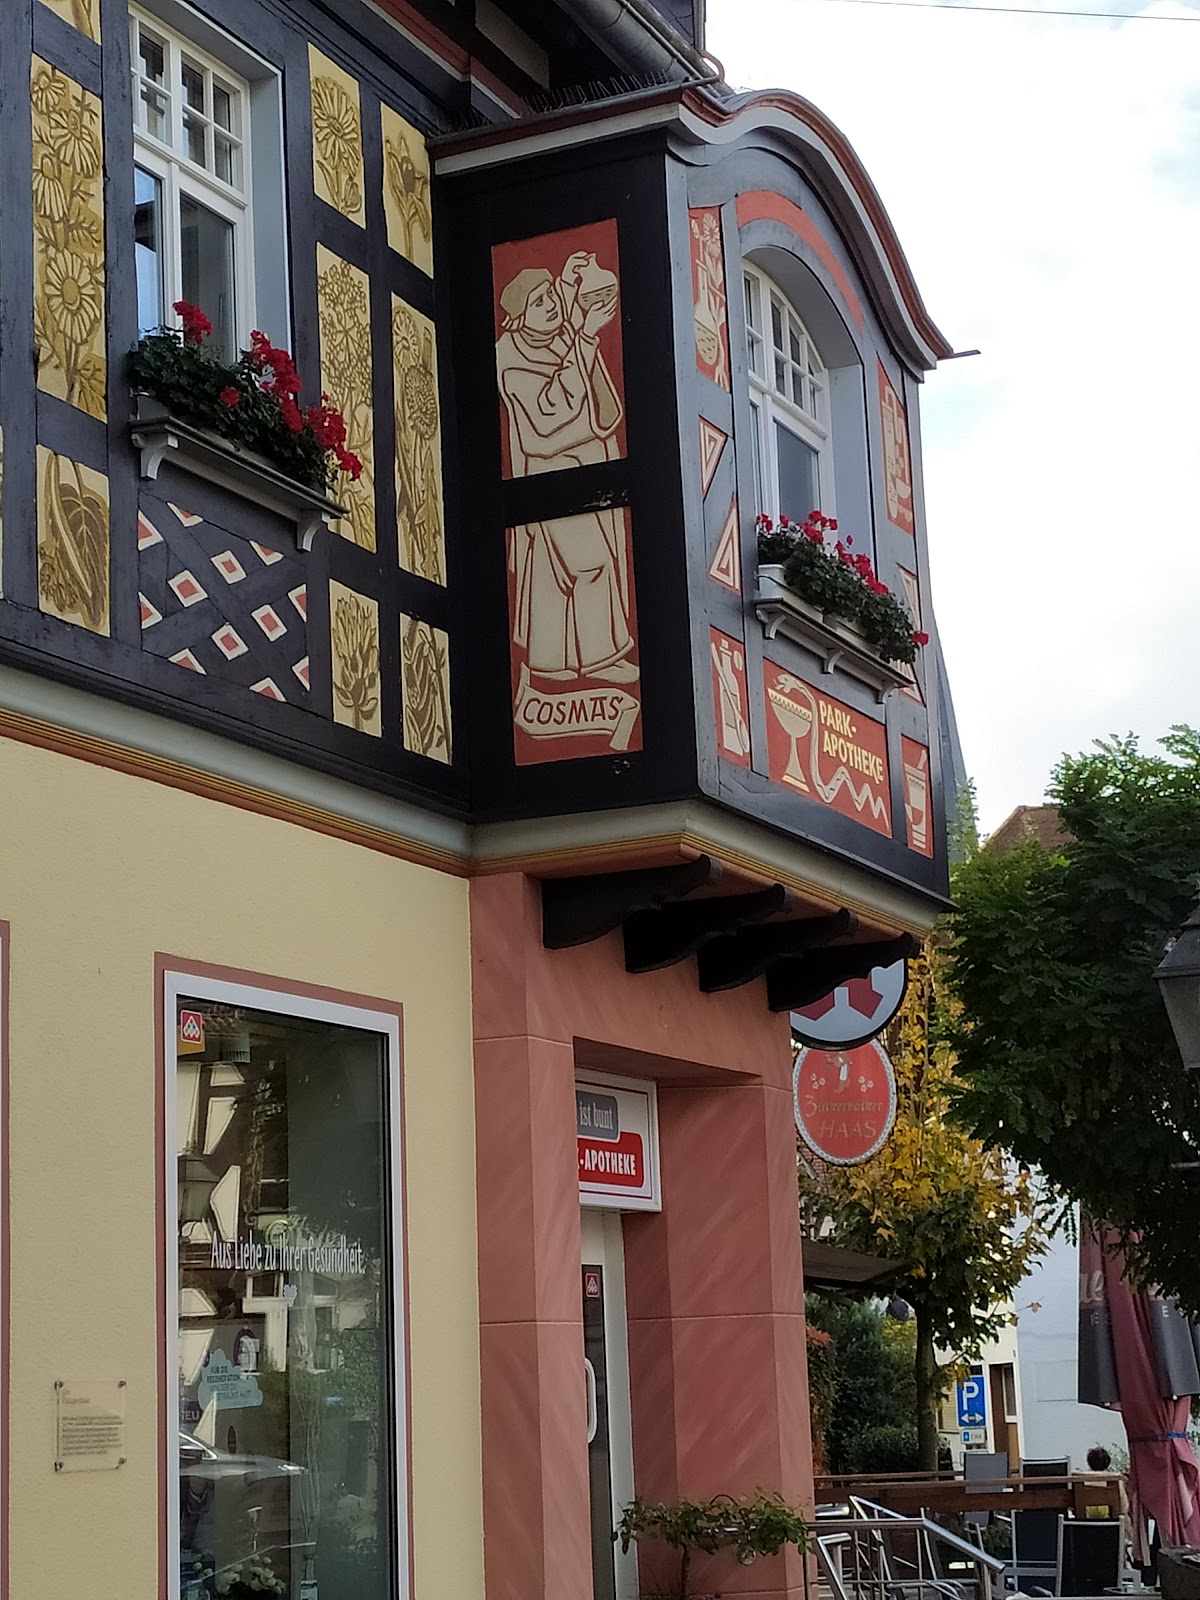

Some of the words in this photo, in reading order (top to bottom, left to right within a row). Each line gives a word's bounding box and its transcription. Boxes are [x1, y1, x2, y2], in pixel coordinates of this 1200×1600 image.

[523, 696, 623, 725] COSMAS
[819, 700, 857, 738] PARK-
[823, 730, 884, 784] APOTHEKE
[579, 1101, 591, 1127] ist
[593, 1102, 613, 1130] bunt
[820, 1119, 876, 1138] HAAS
[577, 1147, 636, 1176] -APOTHEKE
[211, 1230, 232, 1269] Aus
[234, 1229, 262, 1270] Liebe
[265, 1244, 277, 1270] zu
[279, 1232, 305, 1271] Ihrer
[308, 1235, 366, 1274] Gesundheit.
[962, 1381, 979, 1411] P
